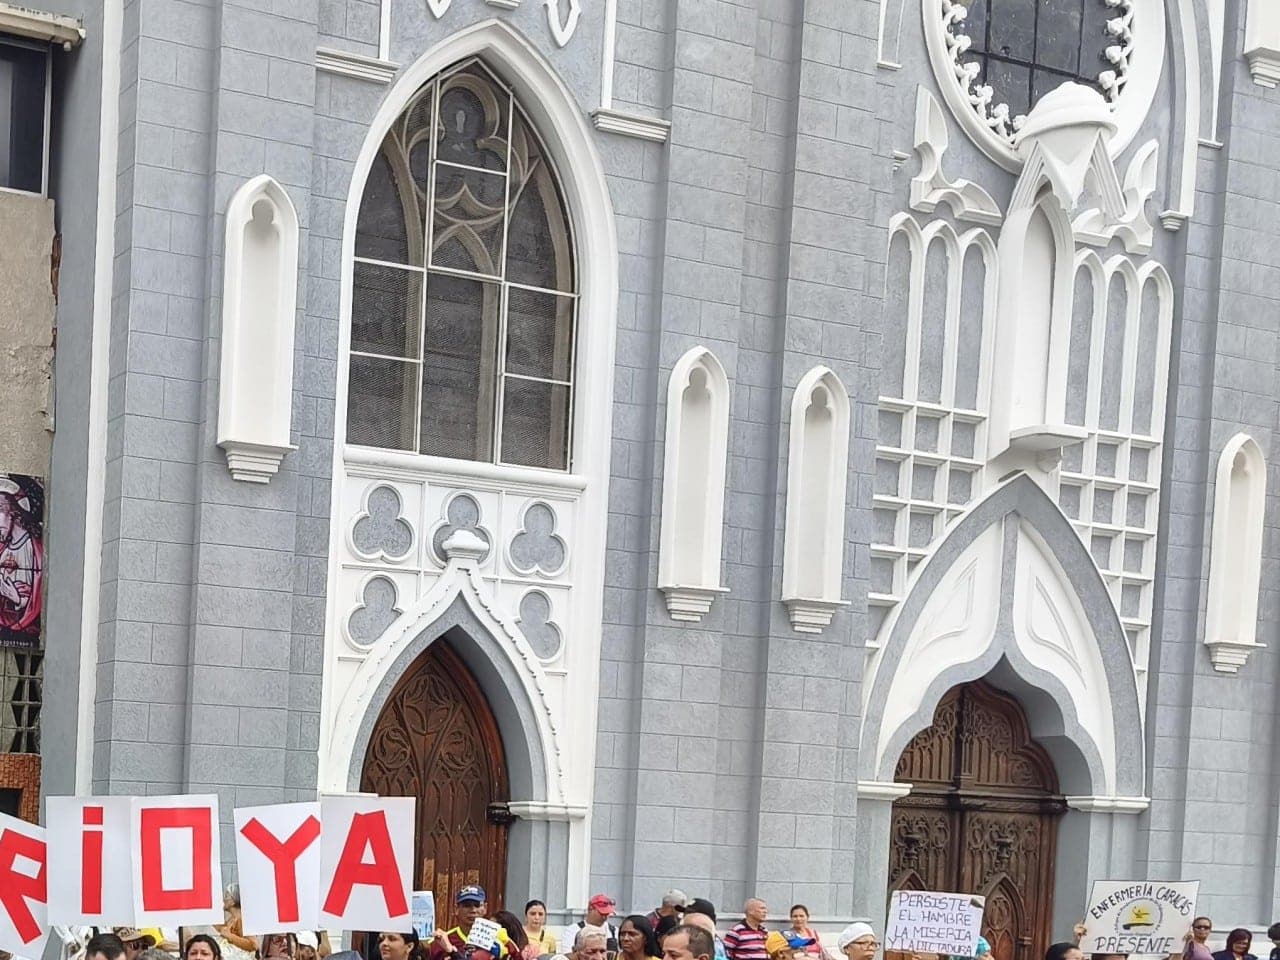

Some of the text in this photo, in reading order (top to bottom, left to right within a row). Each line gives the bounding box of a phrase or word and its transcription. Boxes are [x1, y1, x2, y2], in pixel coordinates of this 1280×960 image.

[899, 891, 968, 911] PERSISTE
[1156, 886, 1192, 915] CARACAS
[898, 909, 971, 926] EL HAMBRE
[894, 925, 971, 942] LA MISERIA
[888, 937, 896, 949] Y
[1095, 936, 1174, 953] PRESENTE
